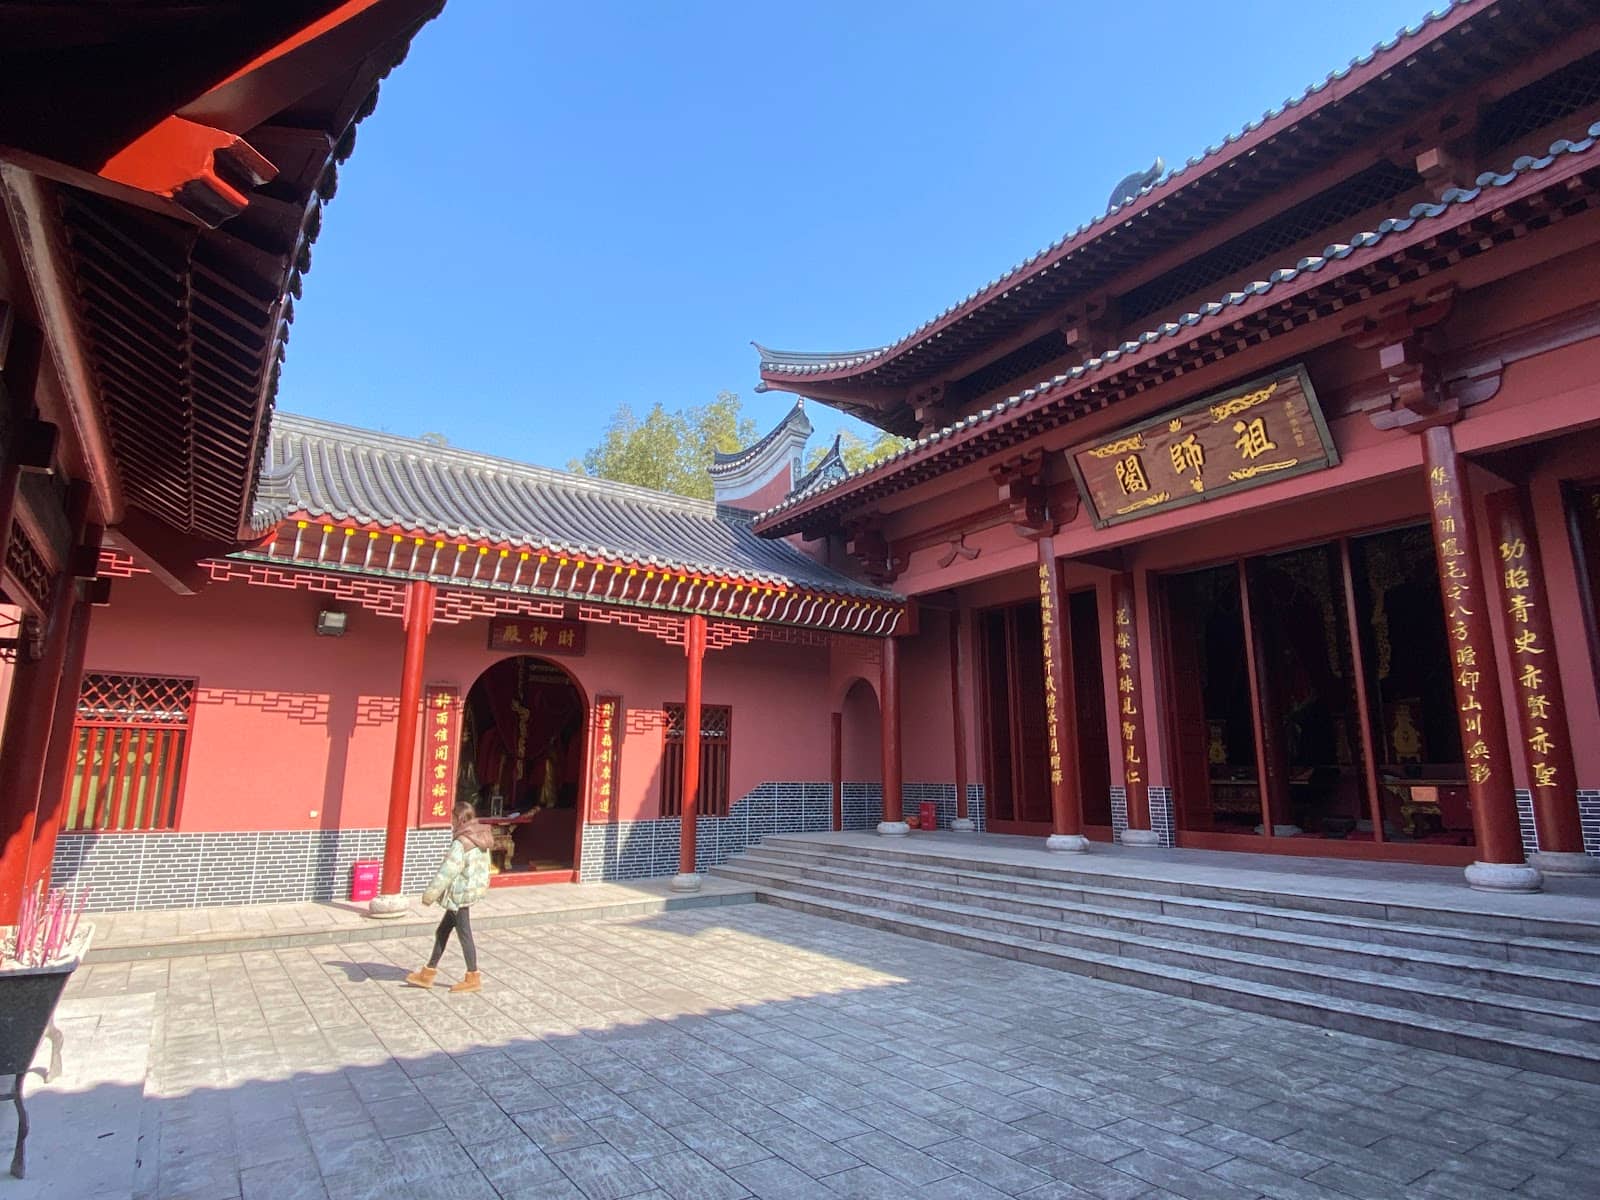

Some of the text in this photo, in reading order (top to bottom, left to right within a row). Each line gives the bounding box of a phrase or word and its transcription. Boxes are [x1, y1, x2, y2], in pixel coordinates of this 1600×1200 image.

[1115, 417, 1277, 495] 祖師閣
[502, 624, 576, 648] 財神殿
[1499, 538, 1558, 787] 功昭青史亦賢亦聖
